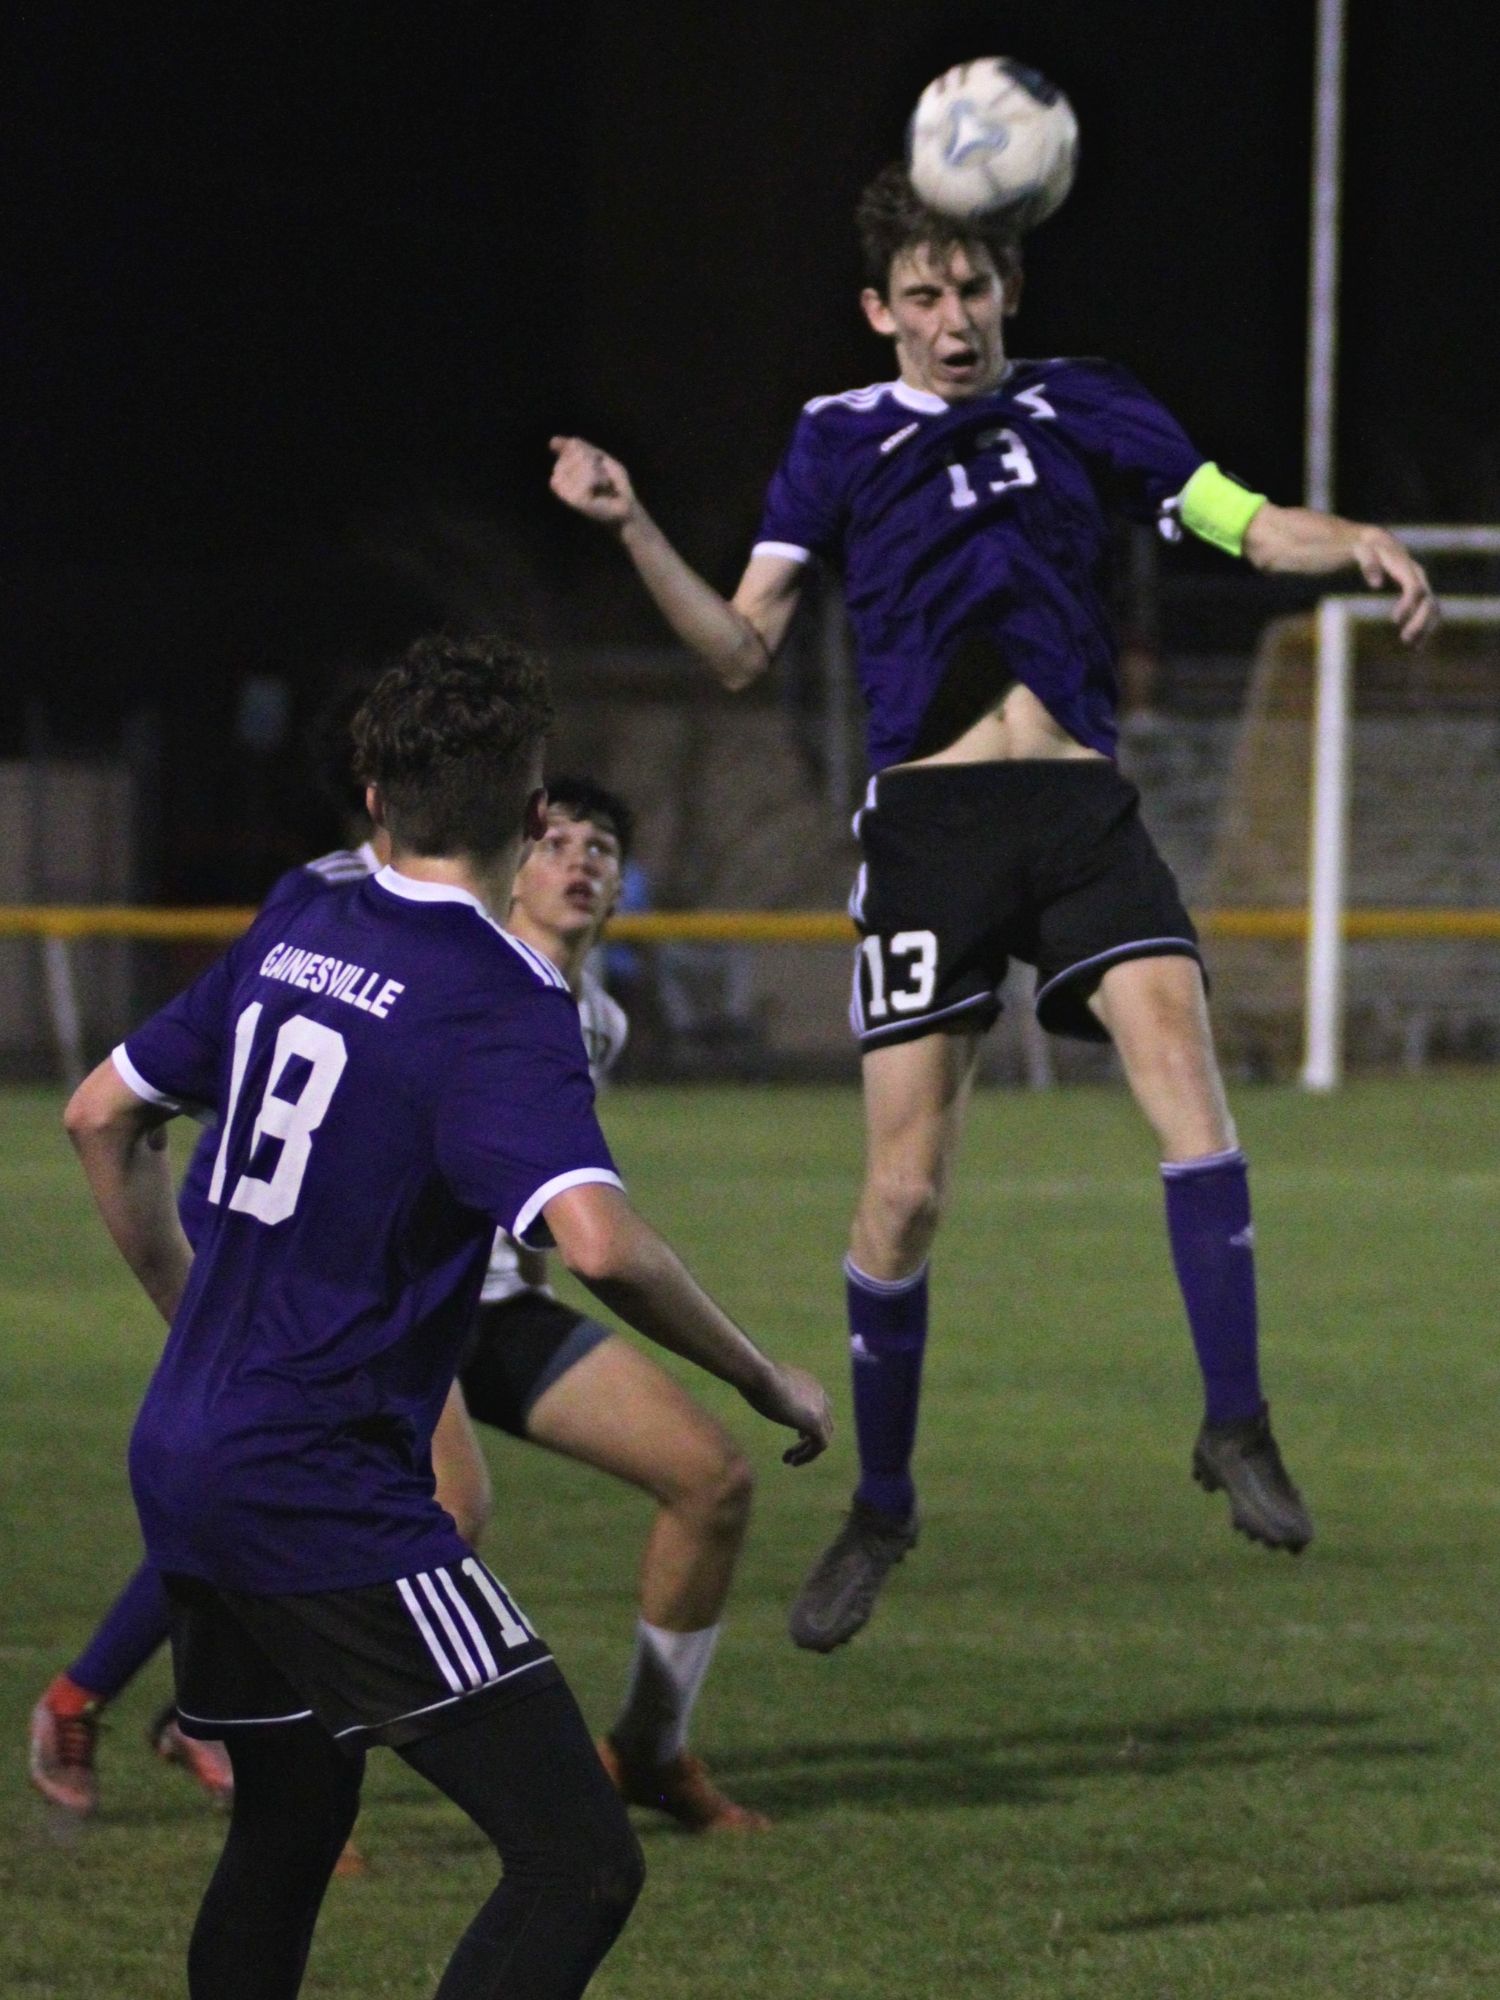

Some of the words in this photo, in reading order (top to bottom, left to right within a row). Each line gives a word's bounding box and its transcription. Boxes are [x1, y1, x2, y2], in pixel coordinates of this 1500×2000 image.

[947, 428, 1037, 508] 13
[259, 942, 405, 1018] GAINESVILLE
[863, 930, 937, 1016] 13
[208, 1001, 347, 1225] 18
[461, 1557, 538, 1648] 1
